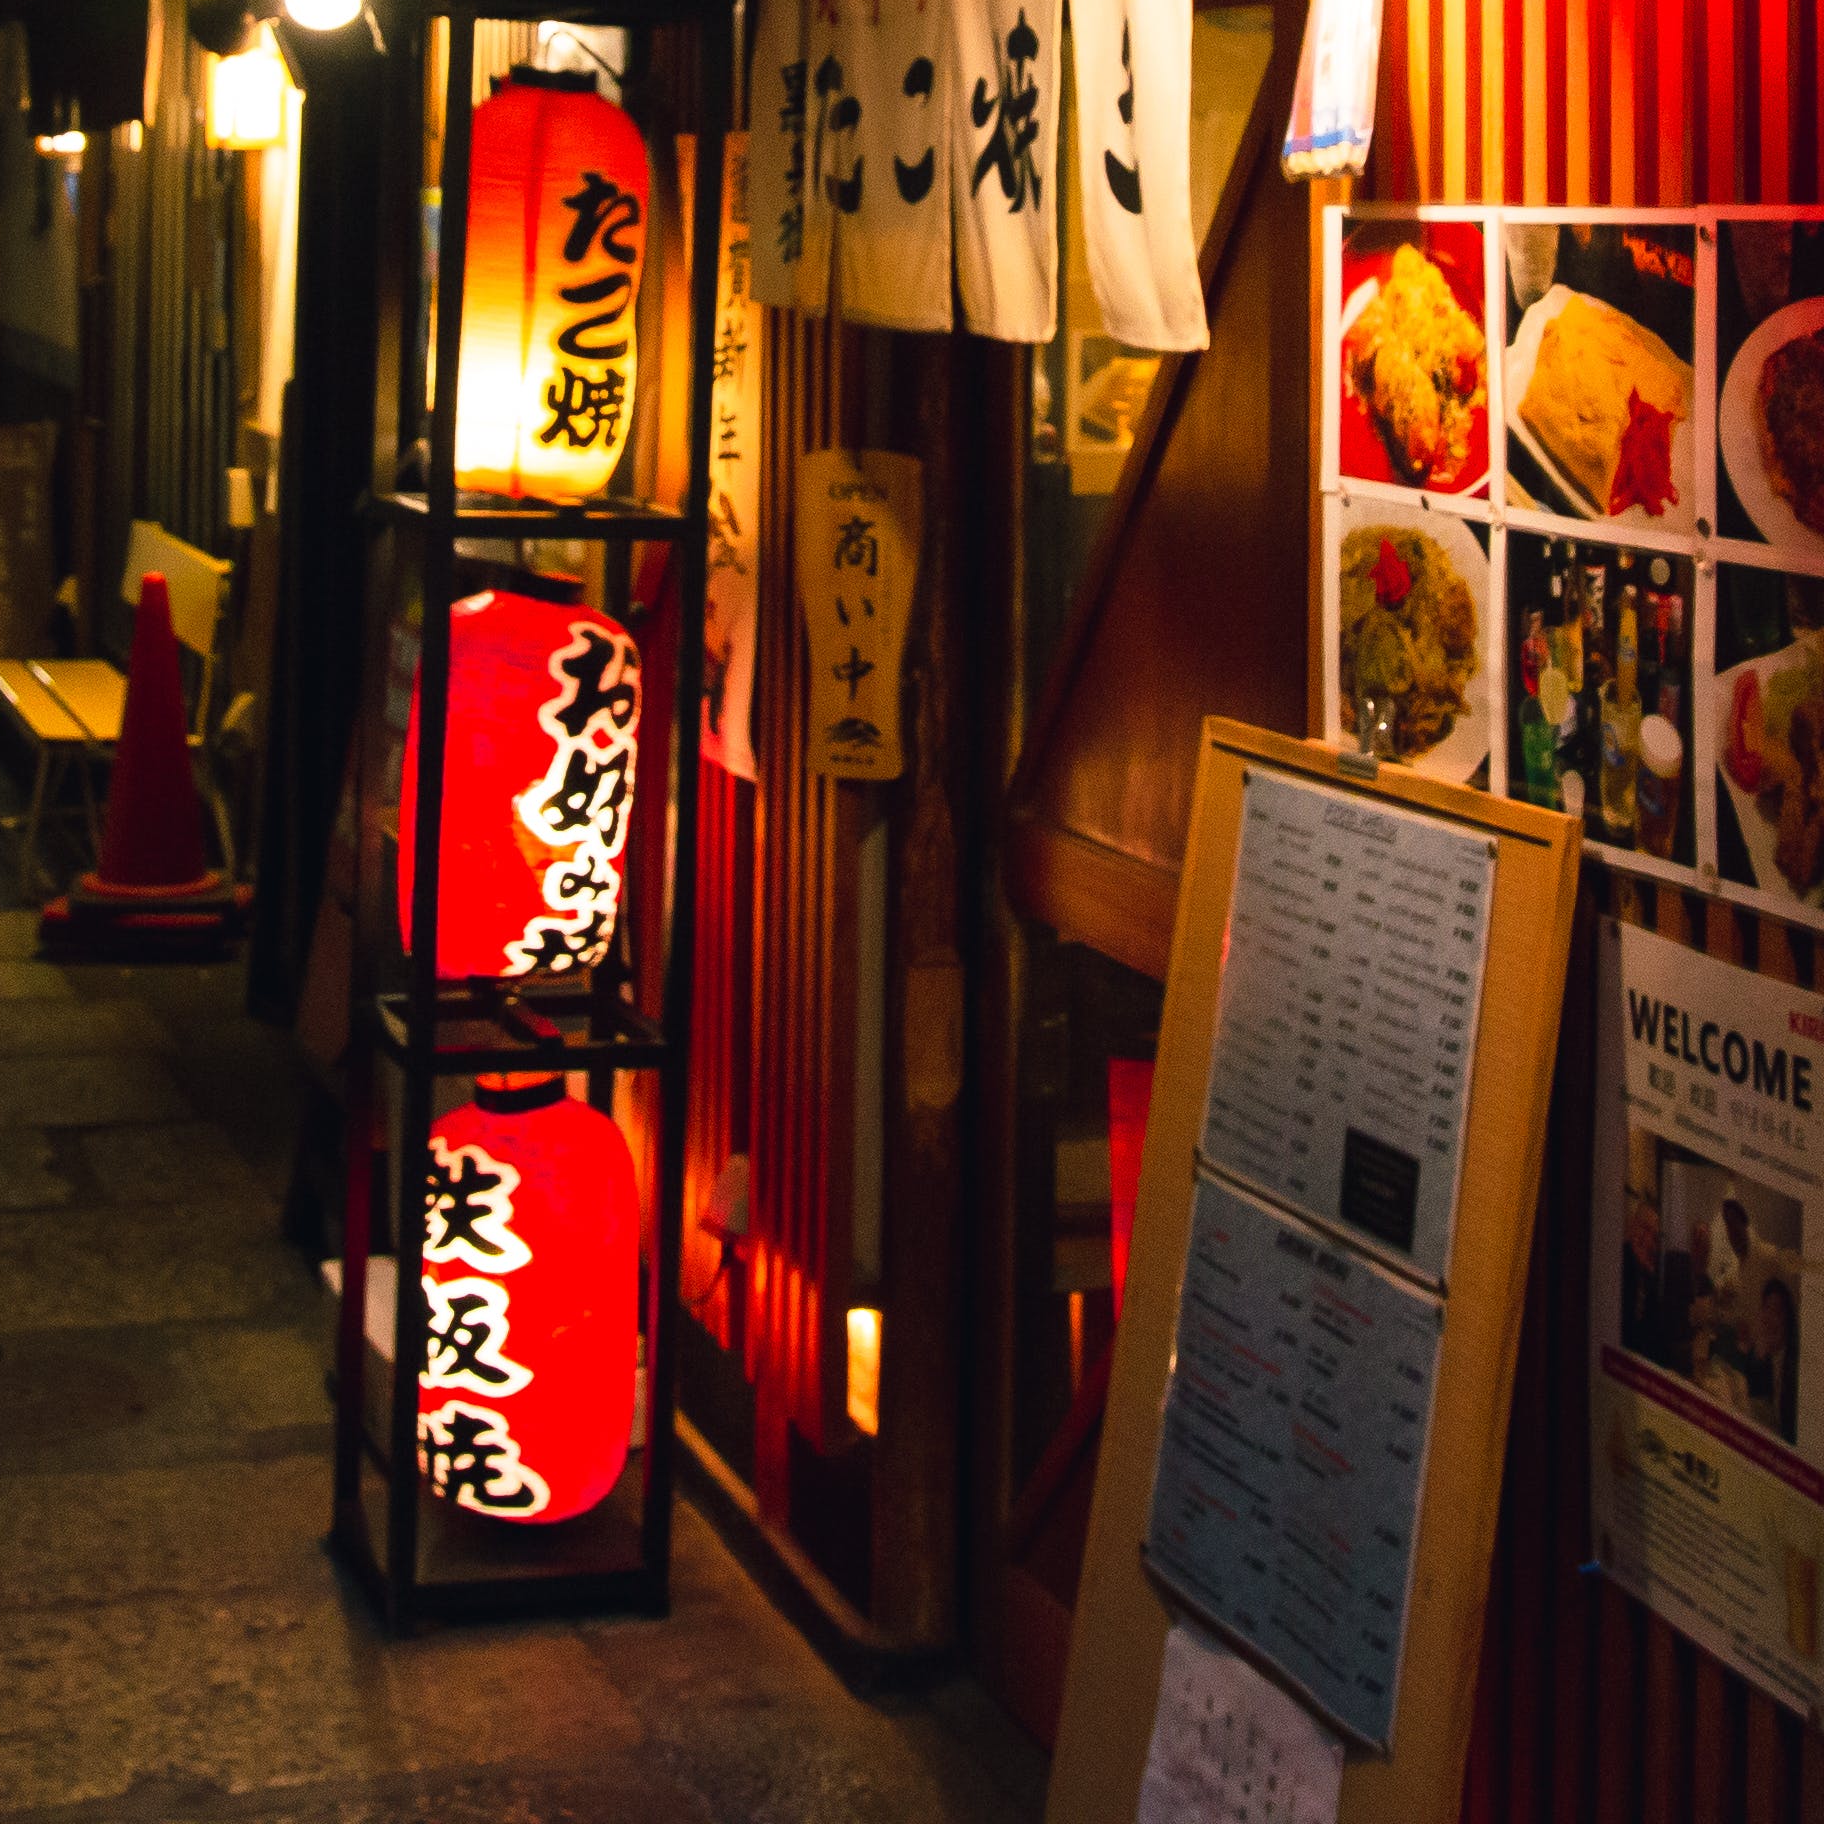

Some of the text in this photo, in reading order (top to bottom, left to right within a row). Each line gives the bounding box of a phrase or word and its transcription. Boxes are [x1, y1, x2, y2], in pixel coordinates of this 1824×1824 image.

[539, 169, 642, 450] たこ焼
[834, 516, 877, 701] 商い中
[1629, 989, 1813, 1113] WELCOME
